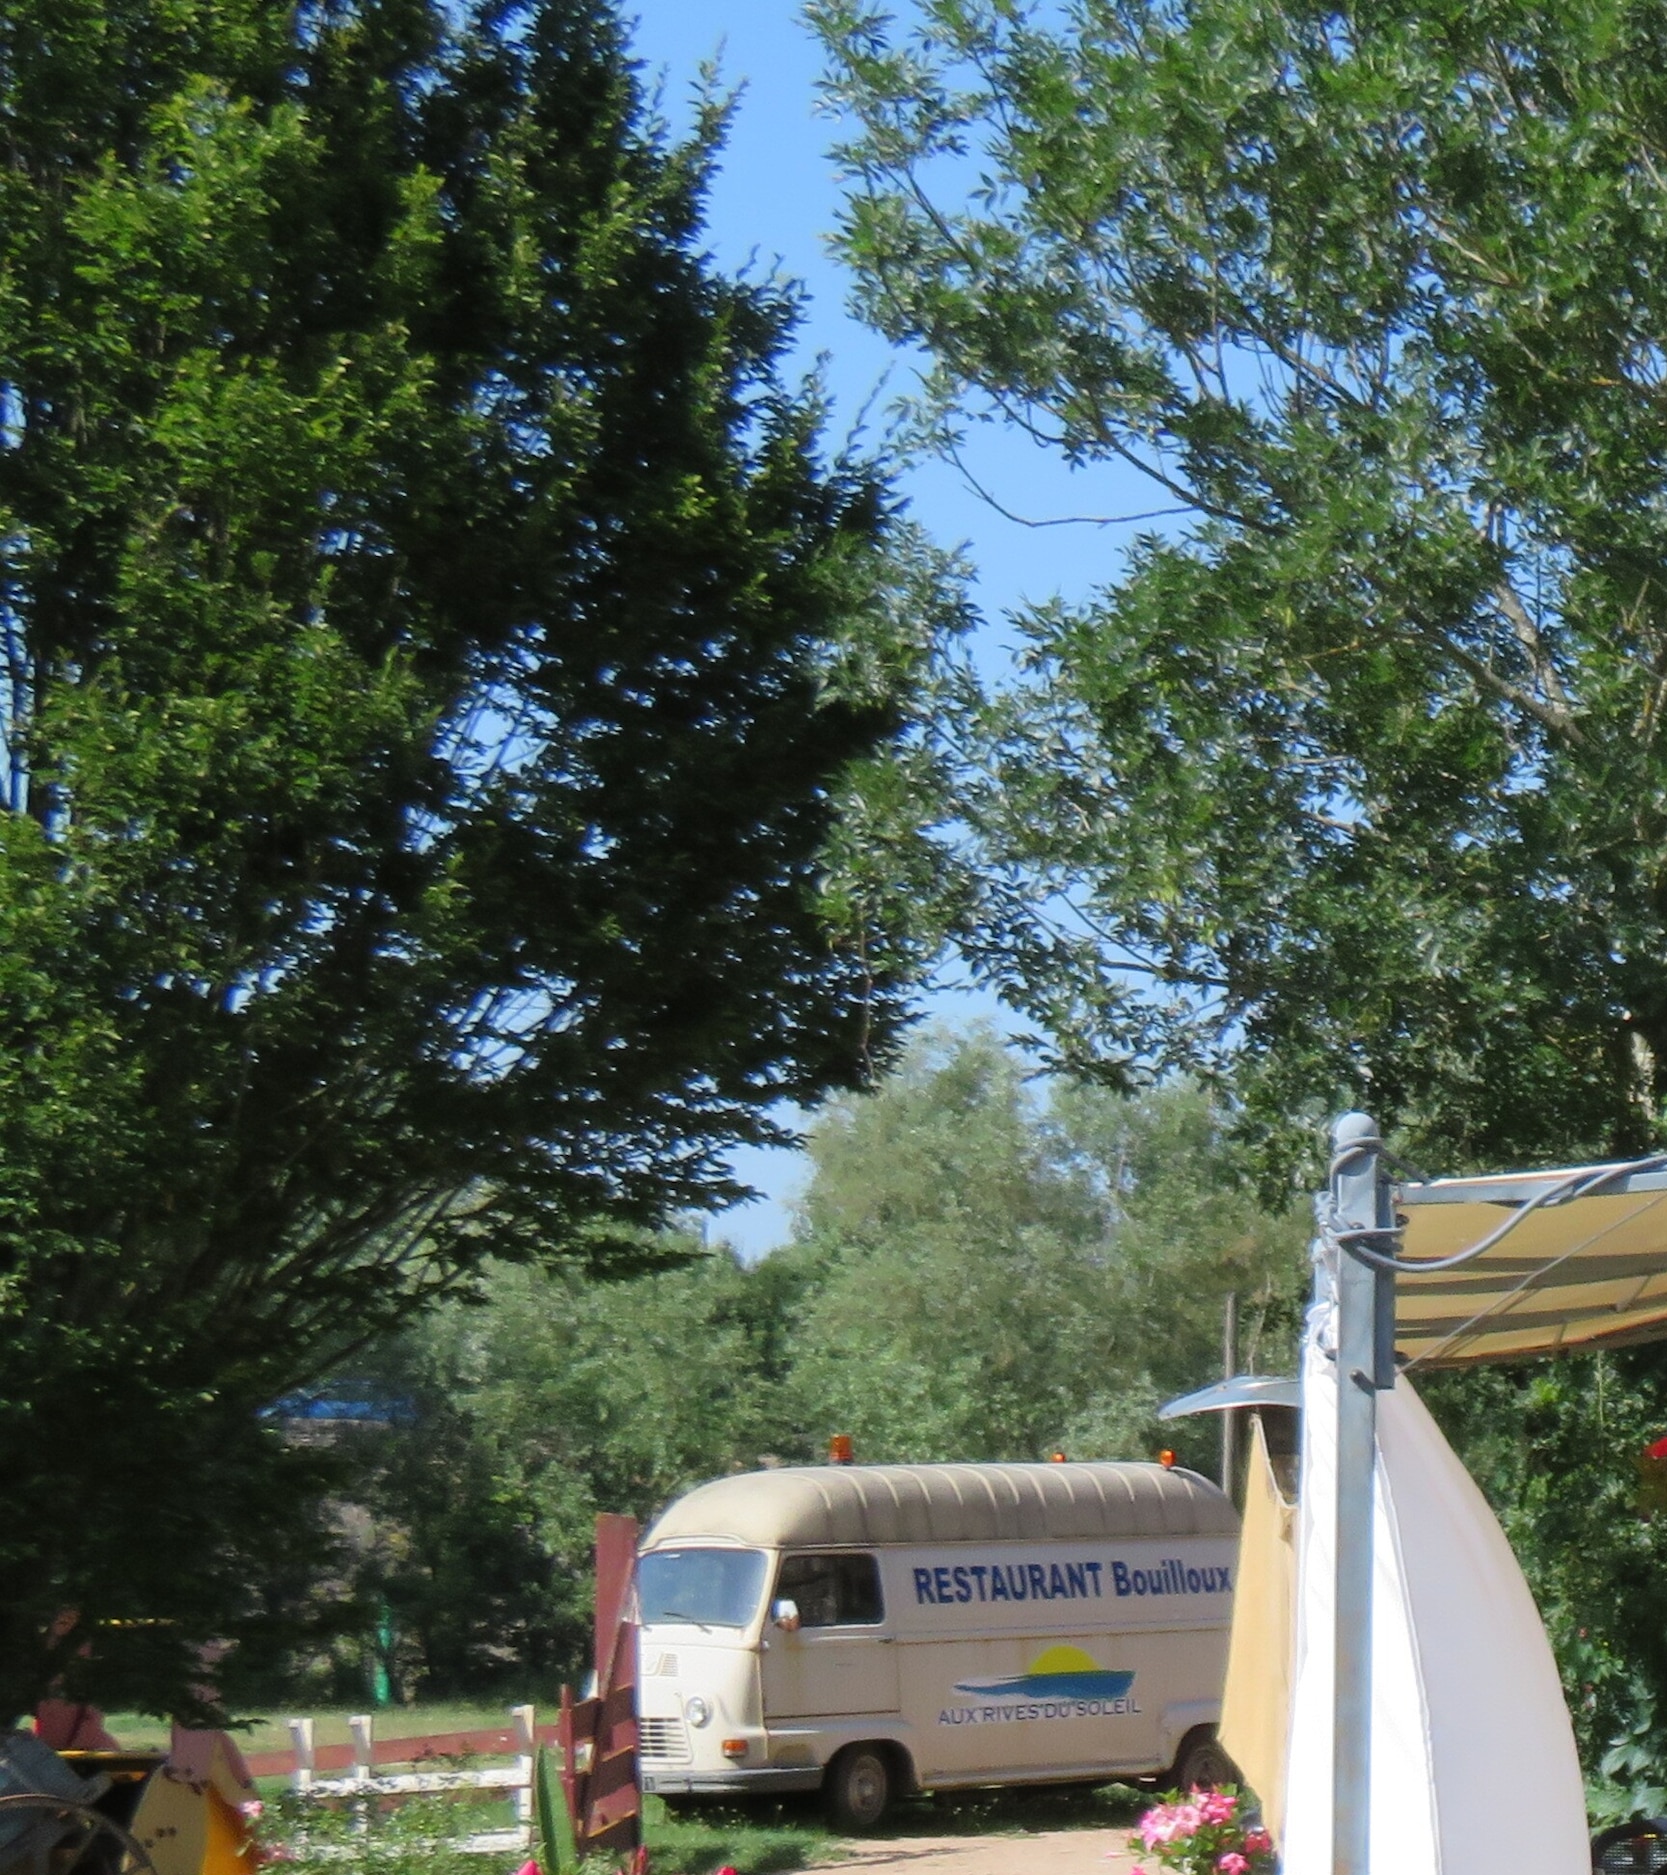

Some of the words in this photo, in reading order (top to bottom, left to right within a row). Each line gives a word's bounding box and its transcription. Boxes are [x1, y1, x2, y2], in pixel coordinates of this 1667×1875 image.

[912, 1562, 1103, 1604] RESTAURANT
[1111, 1558, 1232, 1597] Bouilloux
[938, 1708, 983, 1726] AUX
[983, 1703, 1041, 1724] RIVES
[1045, 1701, 1071, 1719] DU
[1076, 1699, 1143, 1718] SOLEIL
